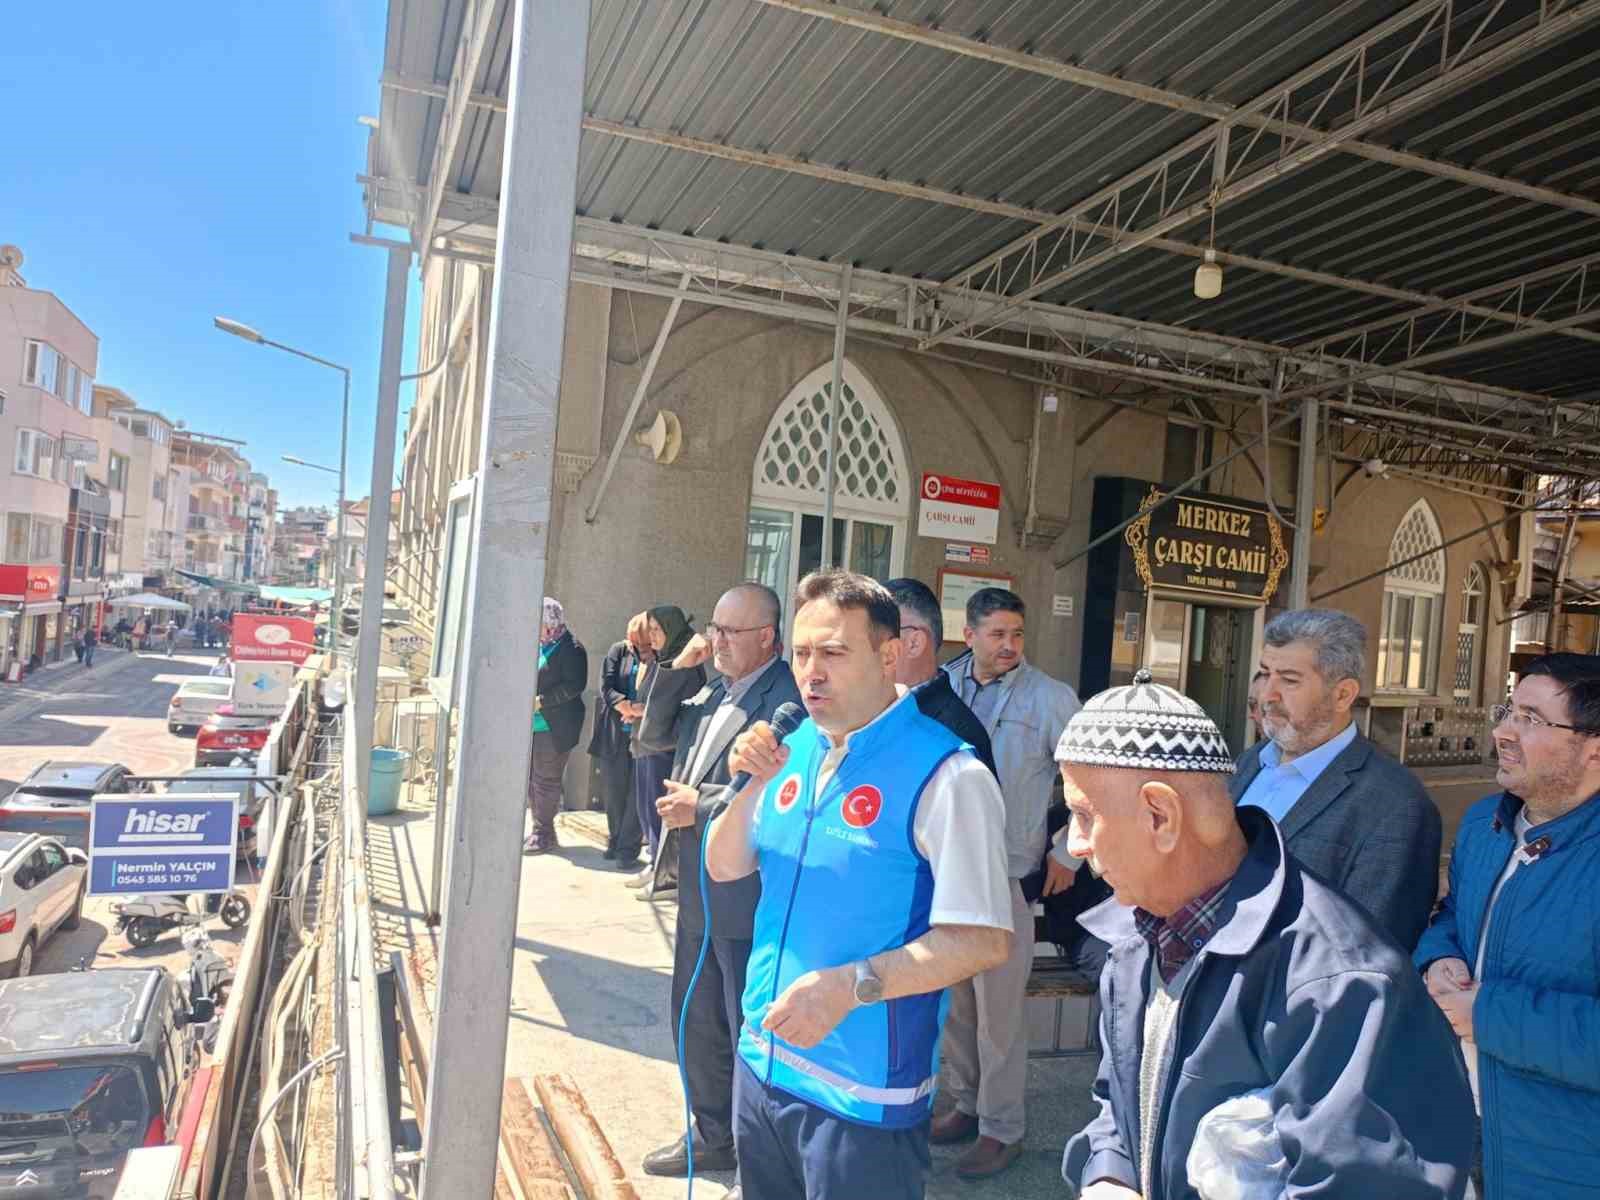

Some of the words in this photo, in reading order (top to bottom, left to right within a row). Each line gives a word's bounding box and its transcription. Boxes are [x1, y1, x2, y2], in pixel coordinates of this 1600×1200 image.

[1176, 503, 1251, 537] MERKEZ
[1155, 536, 1212, 572] ÇARŞI
[1215, 545, 1266, 575] CAMİİ
[124, 808, 206, 833] hisar
[117, 862, 166, 873] Nermin
[169, 861, 216, 874] YALÇIN
[117, 875, 145, 884] 0545
[170, 874, 182, 883] 10
[184, 873, 198, 883] 76
